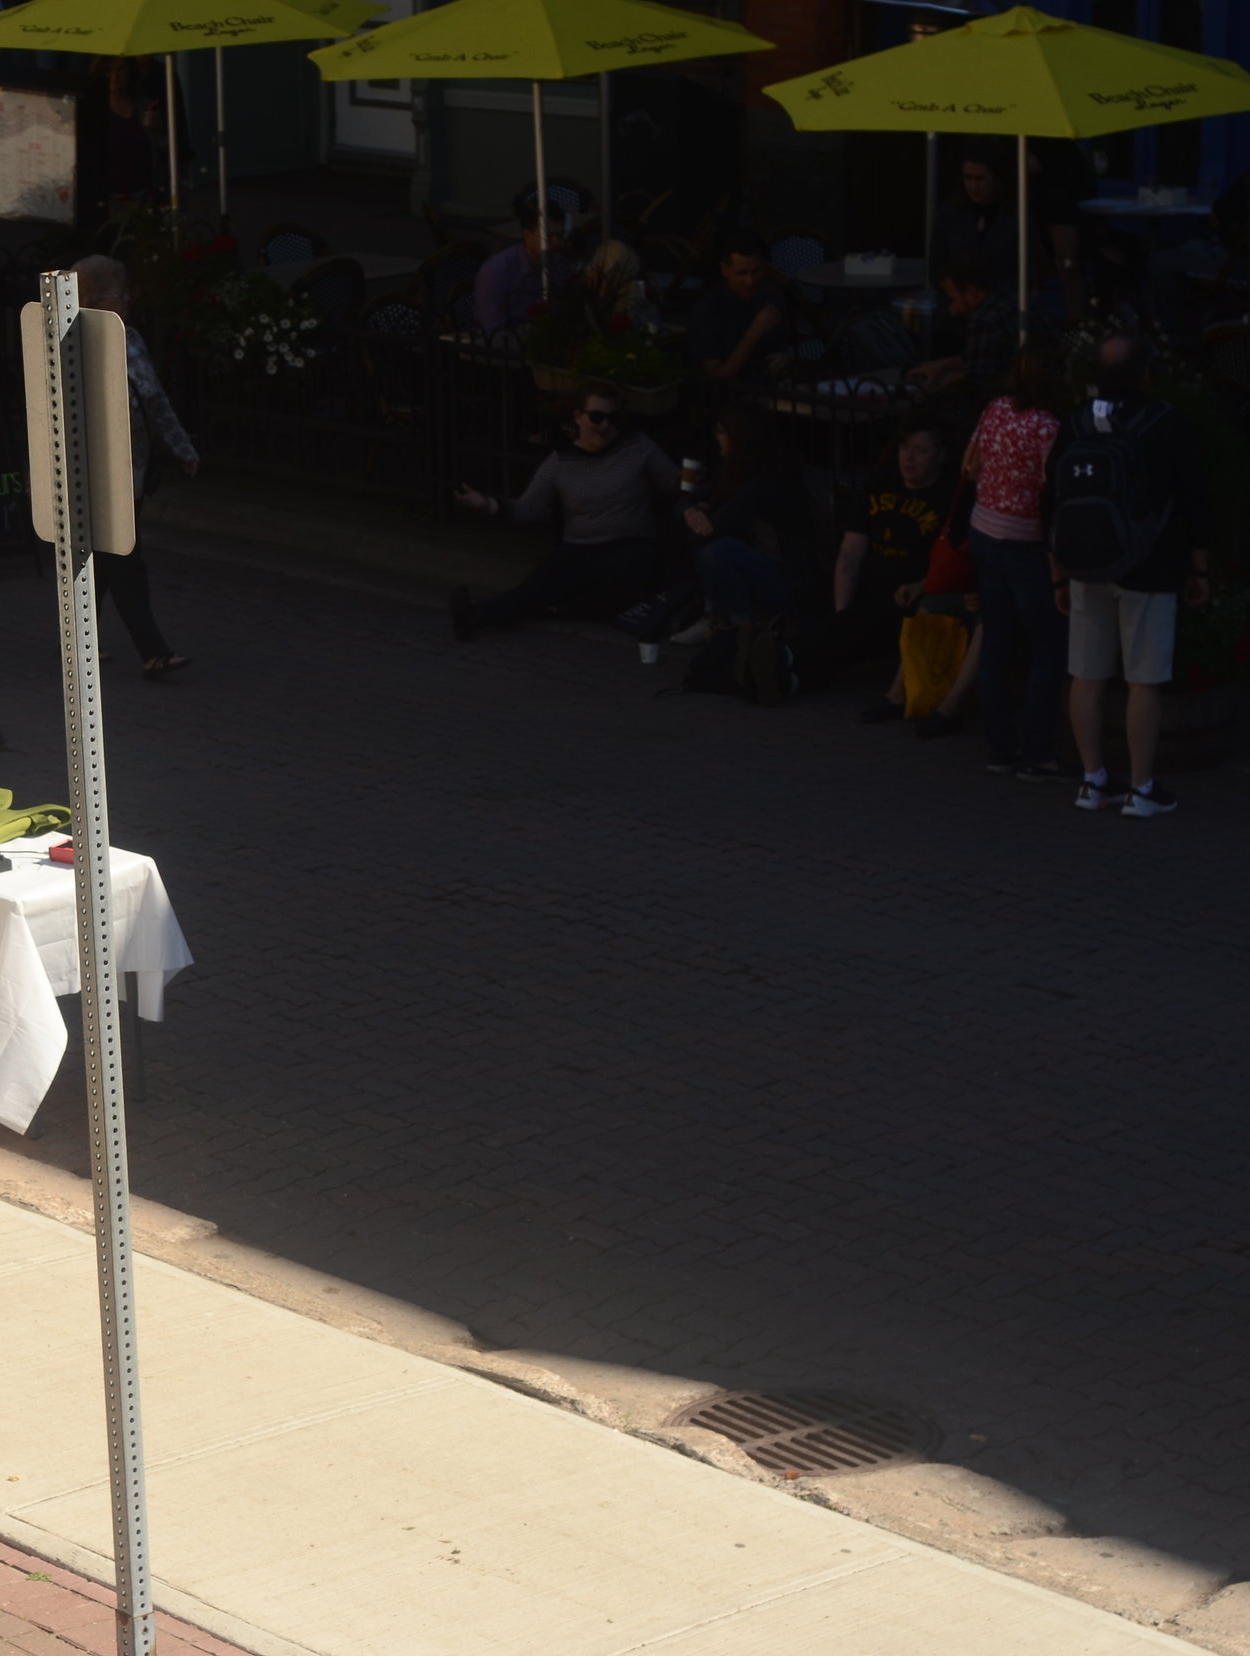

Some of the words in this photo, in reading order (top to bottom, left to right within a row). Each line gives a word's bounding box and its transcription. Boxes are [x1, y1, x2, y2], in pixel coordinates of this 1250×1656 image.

[225, 15, 276, 27] Chair
[638, 31, 687, 43] Chair
[1144, 83, 1198, 98] Chair
[942, 103, 956, 113] A
